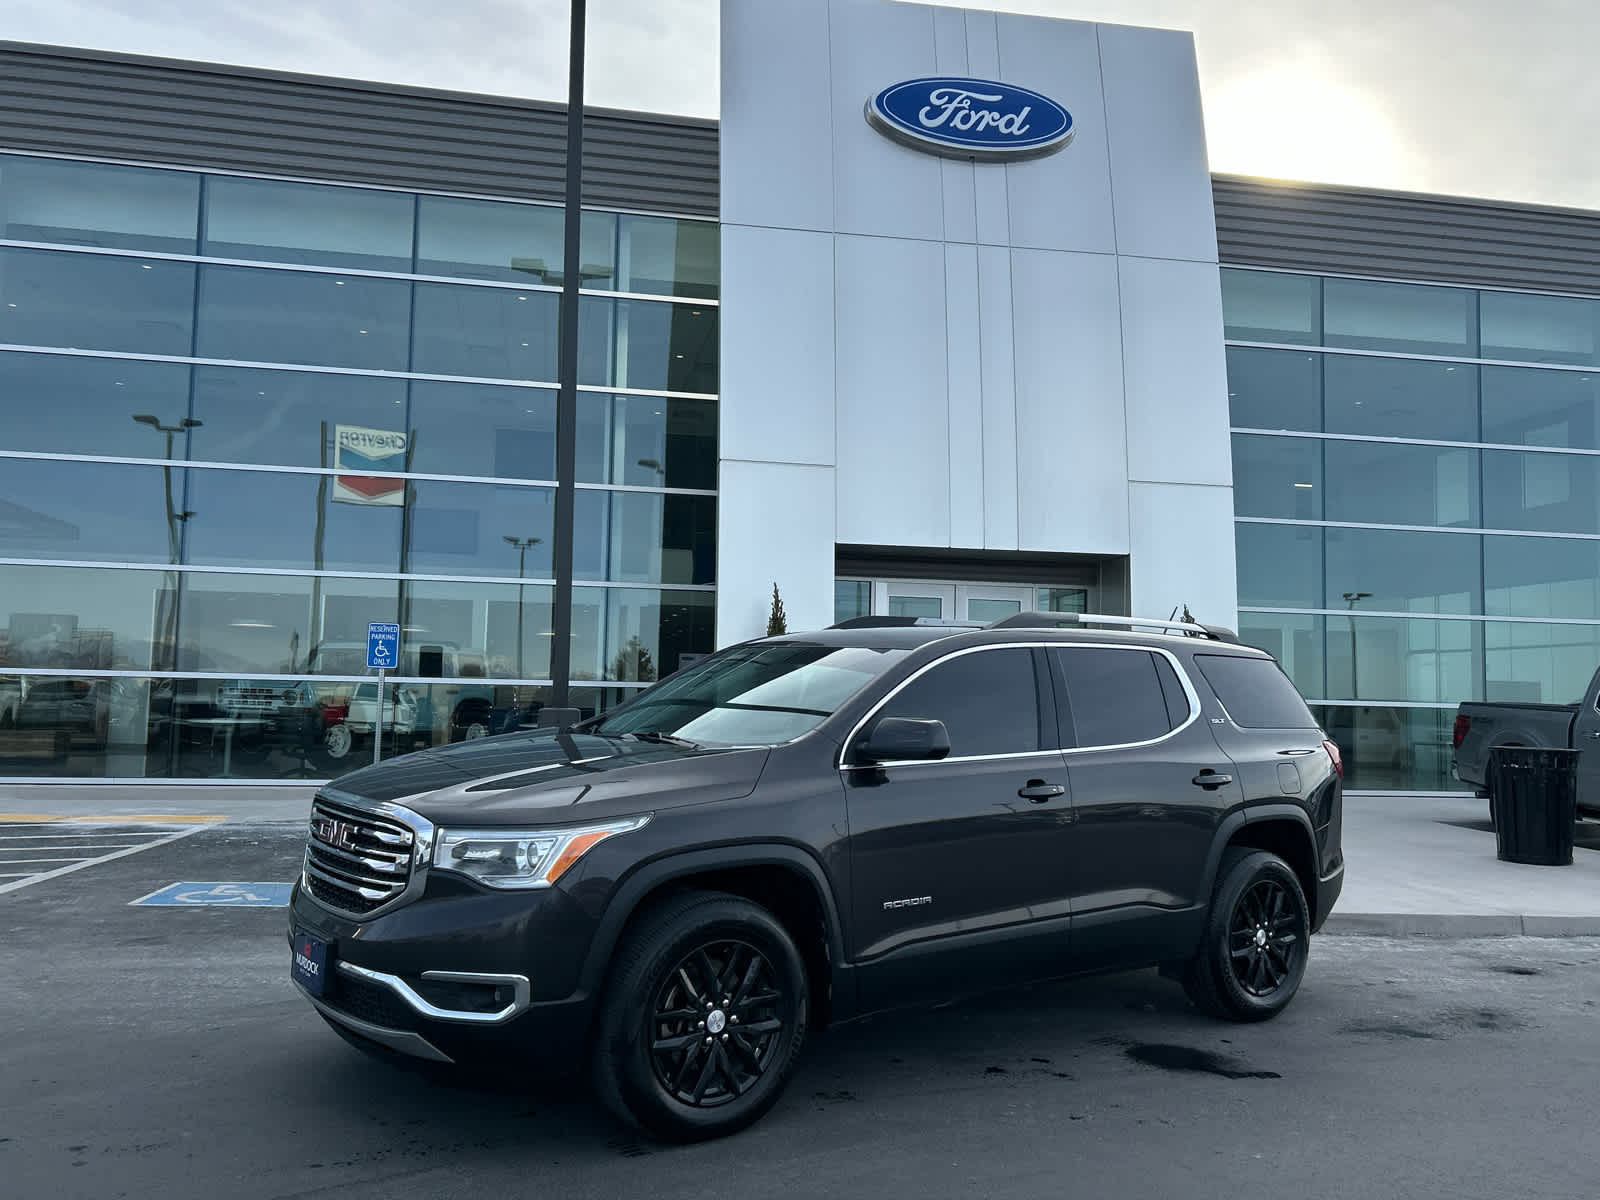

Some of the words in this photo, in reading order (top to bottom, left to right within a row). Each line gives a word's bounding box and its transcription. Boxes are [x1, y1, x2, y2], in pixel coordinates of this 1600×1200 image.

[919, 88, 1031, 136] Ford
[370, 625, 398, 633] RESERVED
[371, 633, 396, 641] PARKING
[373, 657, 391, 666] ONLY
[319, 818, 359, 851] GMC
[883, 896, 932, 910] ACADIA
